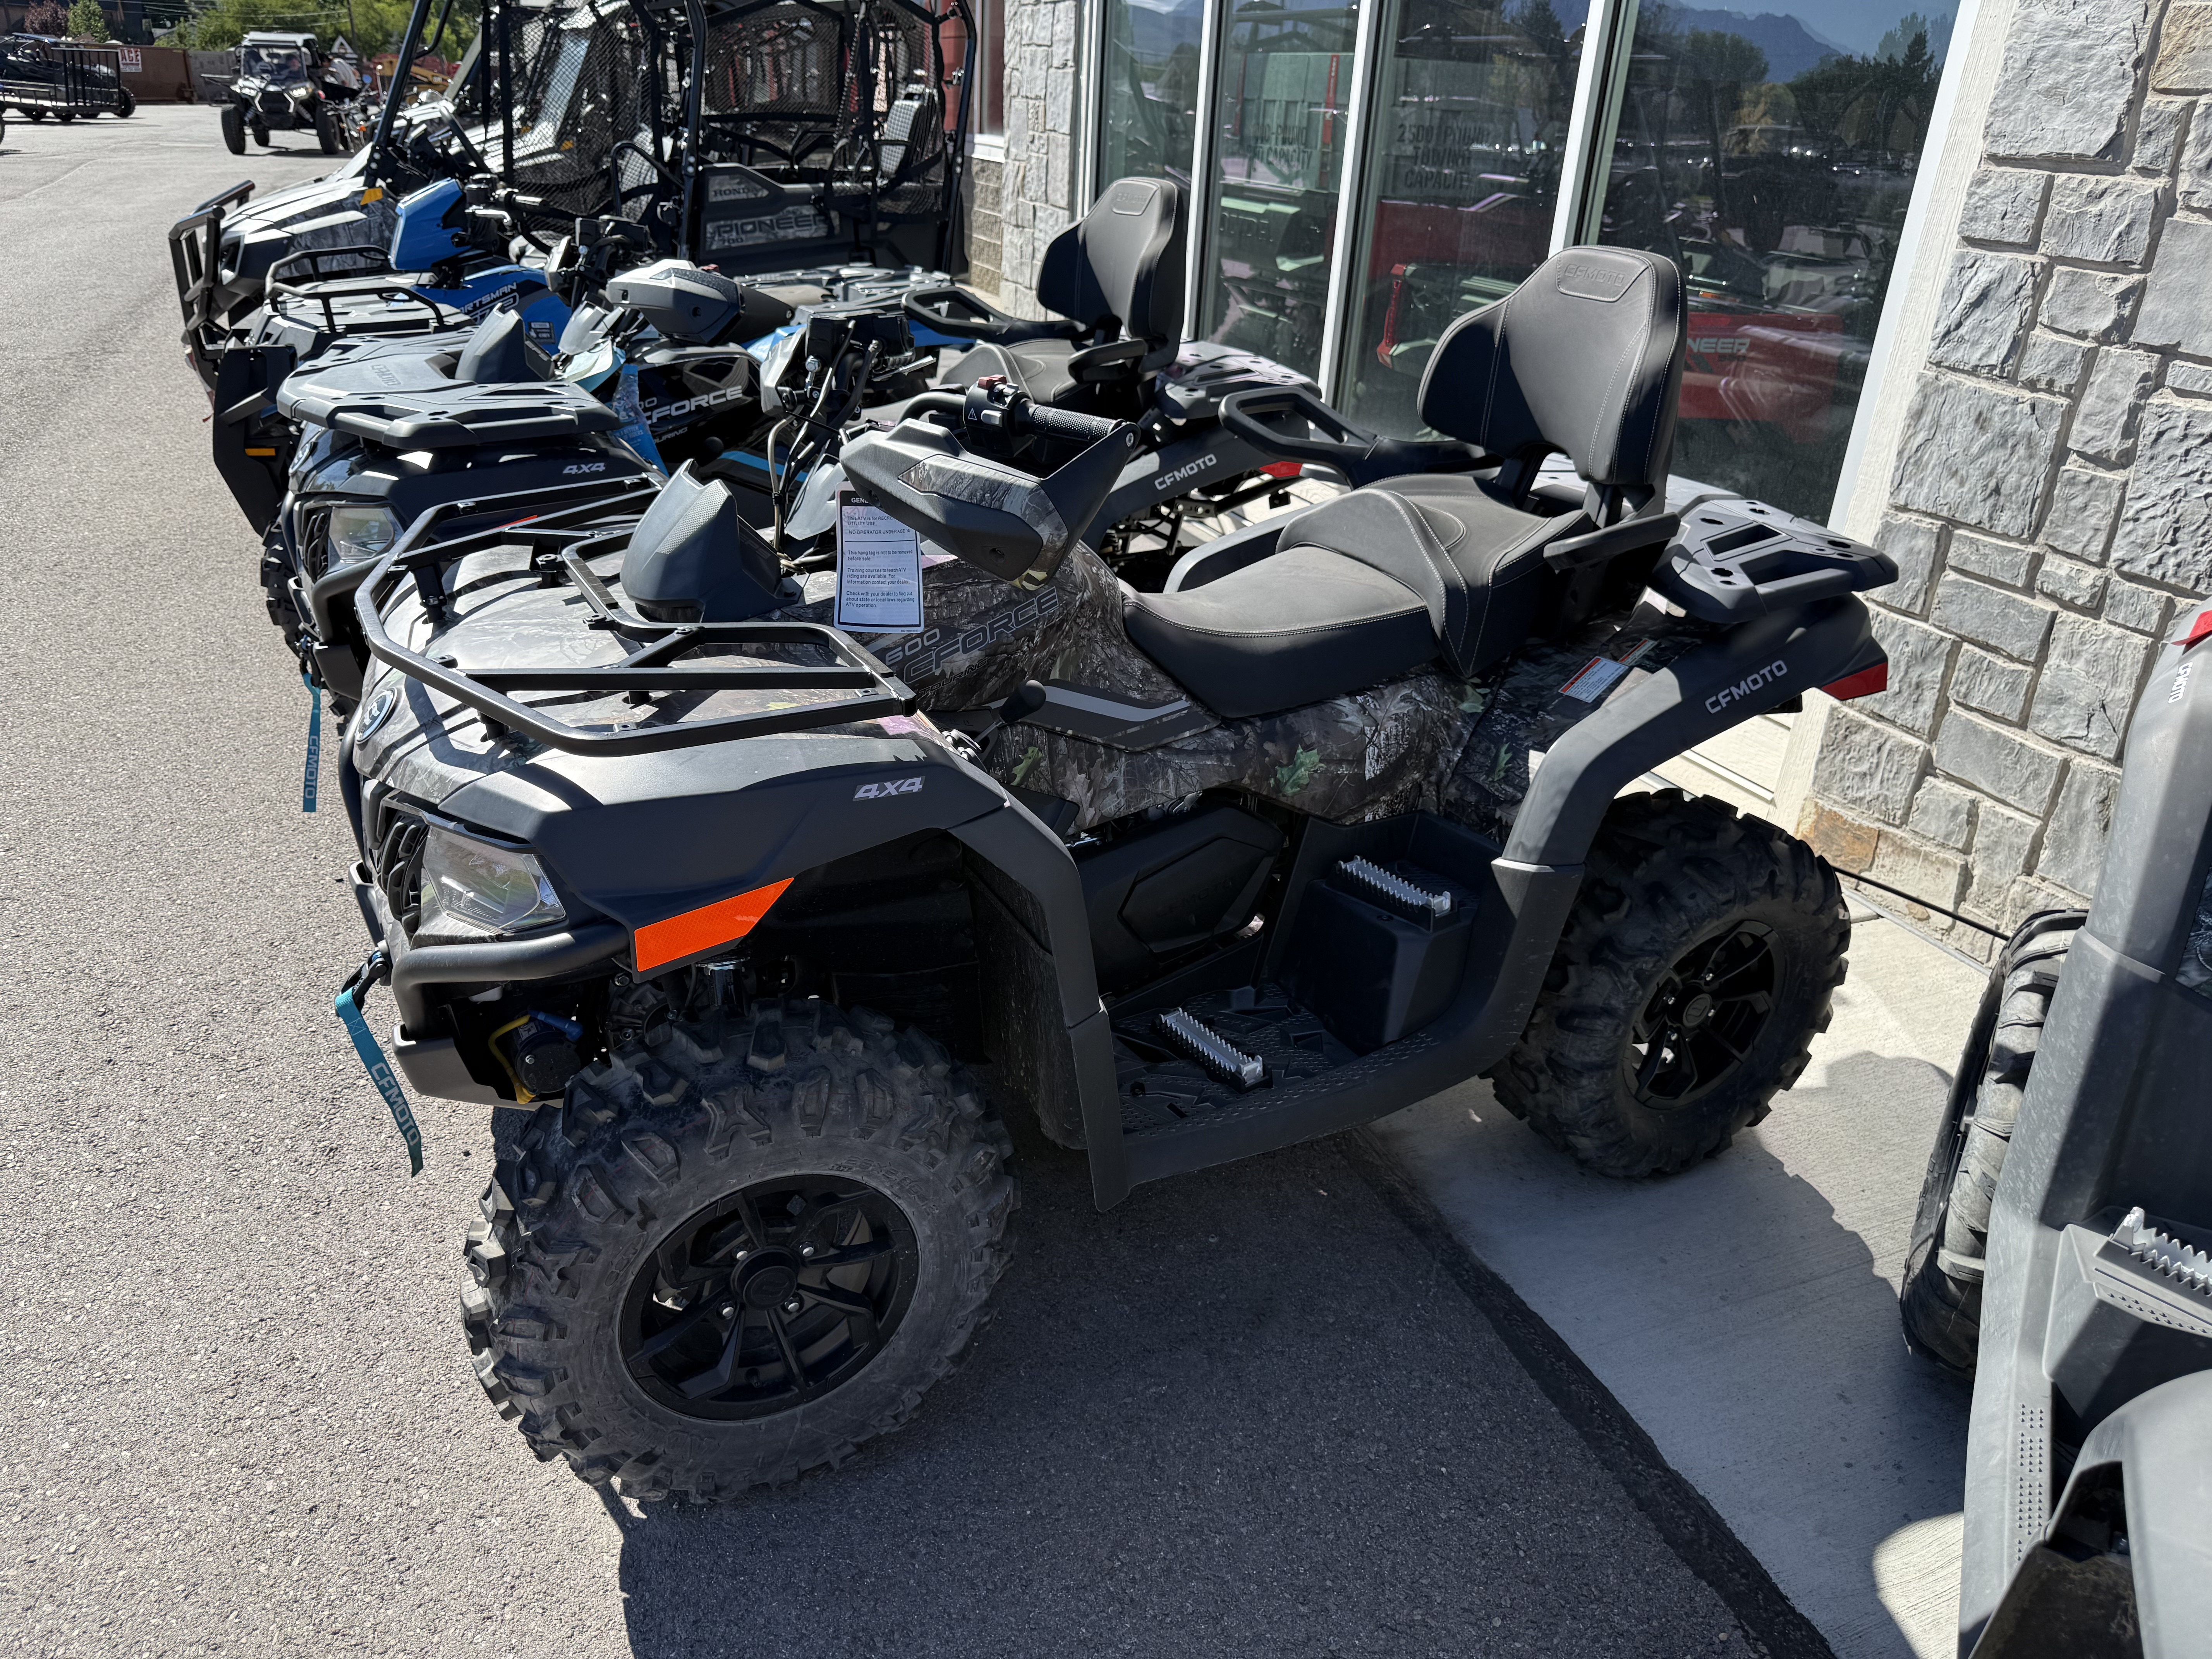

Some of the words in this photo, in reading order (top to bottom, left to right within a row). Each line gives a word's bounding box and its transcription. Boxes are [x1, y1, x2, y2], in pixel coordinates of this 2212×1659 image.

[1563, 264, 1625, 287] CFMOTO
[562, 462, 606, 474] 4X4
[1154, 453, 1217, 490] CFMOTO
[884, 627, 941, 667] 600
[903, 586, 1060, 684] CFORCE
[919, 658, 988, 696] TOURING
[1705, 659, 1787, 715] CFMOTO
[2168, 661, 2193, 704] CFMOTO
[305, 735, 319, 799] CFMOTO
[854, 777, 924, 800] 4X4
[370, 1062, 421, 1146] CFMOTO
